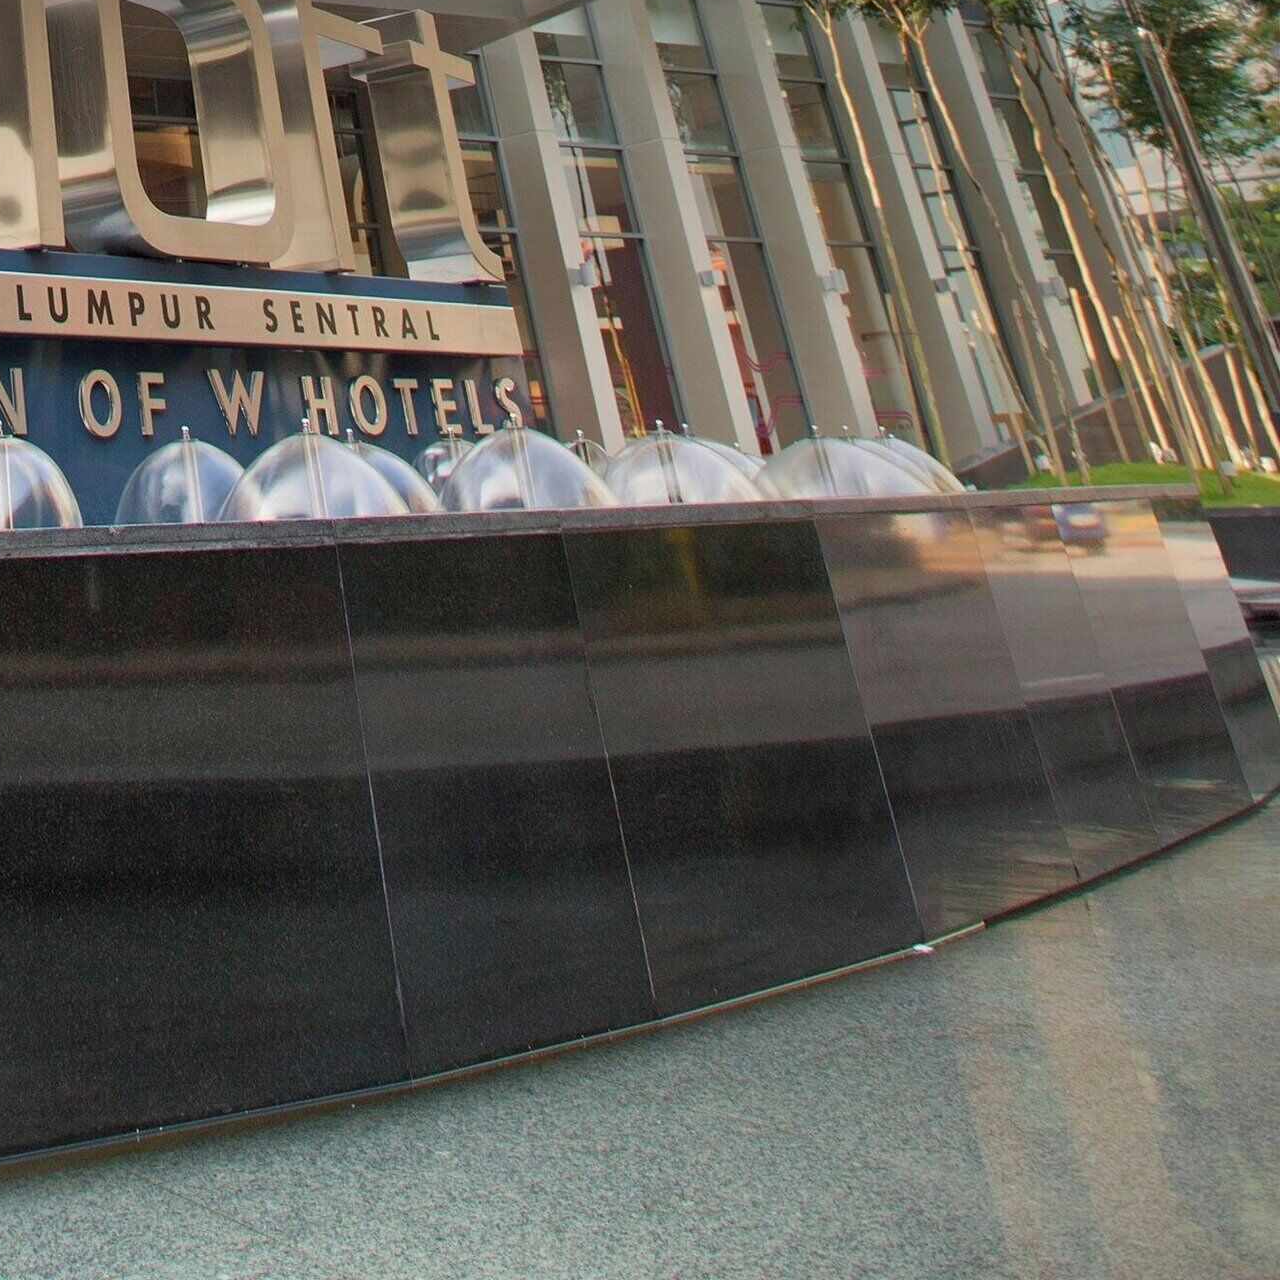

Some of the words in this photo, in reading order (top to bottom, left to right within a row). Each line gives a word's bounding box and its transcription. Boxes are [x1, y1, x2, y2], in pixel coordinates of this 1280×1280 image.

[17, 285, 214, 331] LUMPUR
[262, 299, 440, 341] SENTRAL
[78, 369, 167, 438] OF
[207, 369, 264, 436] W
[301, 375, 522, 437] HOTELS
